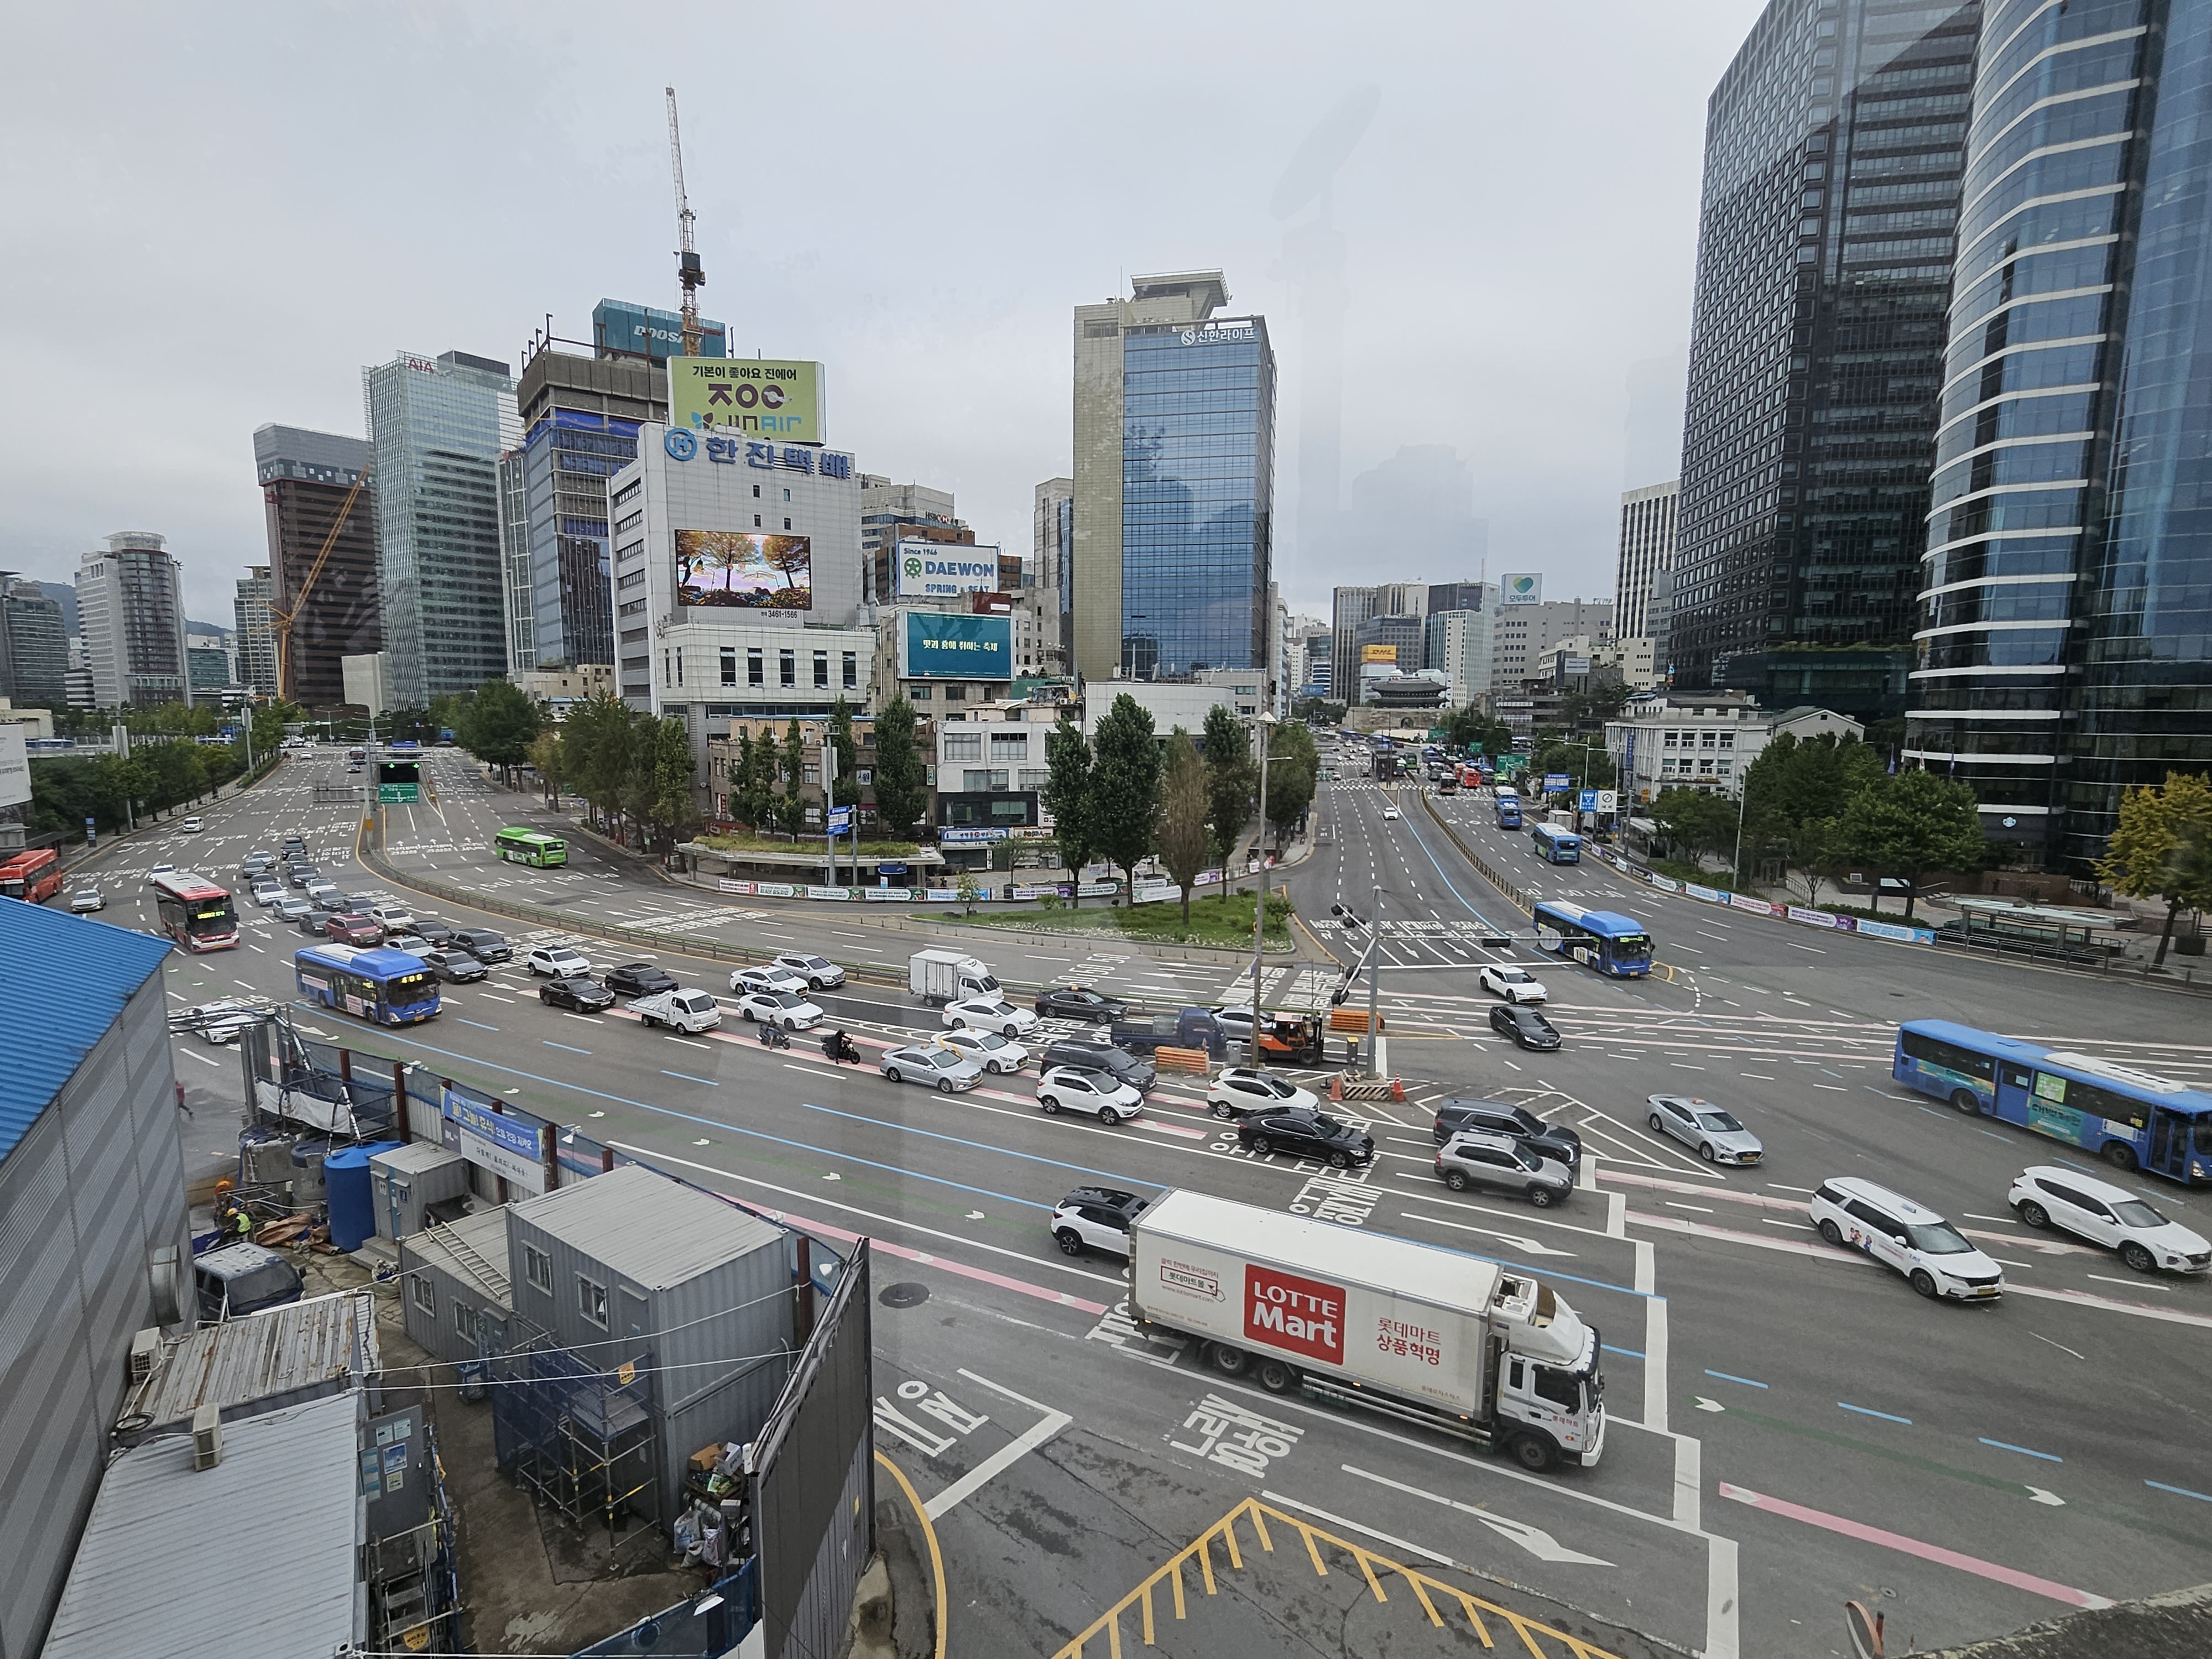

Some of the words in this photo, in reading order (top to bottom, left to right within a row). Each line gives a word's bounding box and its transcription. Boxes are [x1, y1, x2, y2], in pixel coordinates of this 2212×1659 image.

[634, 325, 702, 347] DOOS
[1197, 328, 1255, 343] 신한라이프
[409, 359, 434, 374] AIA
[692, 366, 726, 378] 기본이
[728, 367, 761, 379] 좋아요
[765, 368, 797, 380] 진에어
[706, 436, 851, 478] 한진택배
[925, 561, 994, 577] DAEWON
[925, 583, 957, 594] SPRING
[768, 610, 797, 618] 3461-1566
[923, 639, 938, 649] 맛과
[959, 641, 980, 651] 취하는
[983, 642, 998, 651] 축제
[1087, 953, 1130, 963] 50
[1068, 964, 1115, 975] 50
[401, 973, 422, 984] 408
[1050, 975, 1098, 987] 50
[445, 1130, 454, 1141] DL
[1289, 1176, 1382, 1226] 버스전용
[1168, 1272, 1204, 1288] 롯데마트몰
[1162, 1285, 1214, 1303] www.lottemart.com
[1254, 1281, 1338, 1318] LOTTE
[1253, 1301, 1337, 1348] Mart
[1378, 1317, 1441, 1345] 롯데마트
[1376, 1334, 1441, 1366] 상품혁명
[1552, 1416, 1578, 1428] 롯데마트
[1170, 1393, 1306, 1479] 서울역
